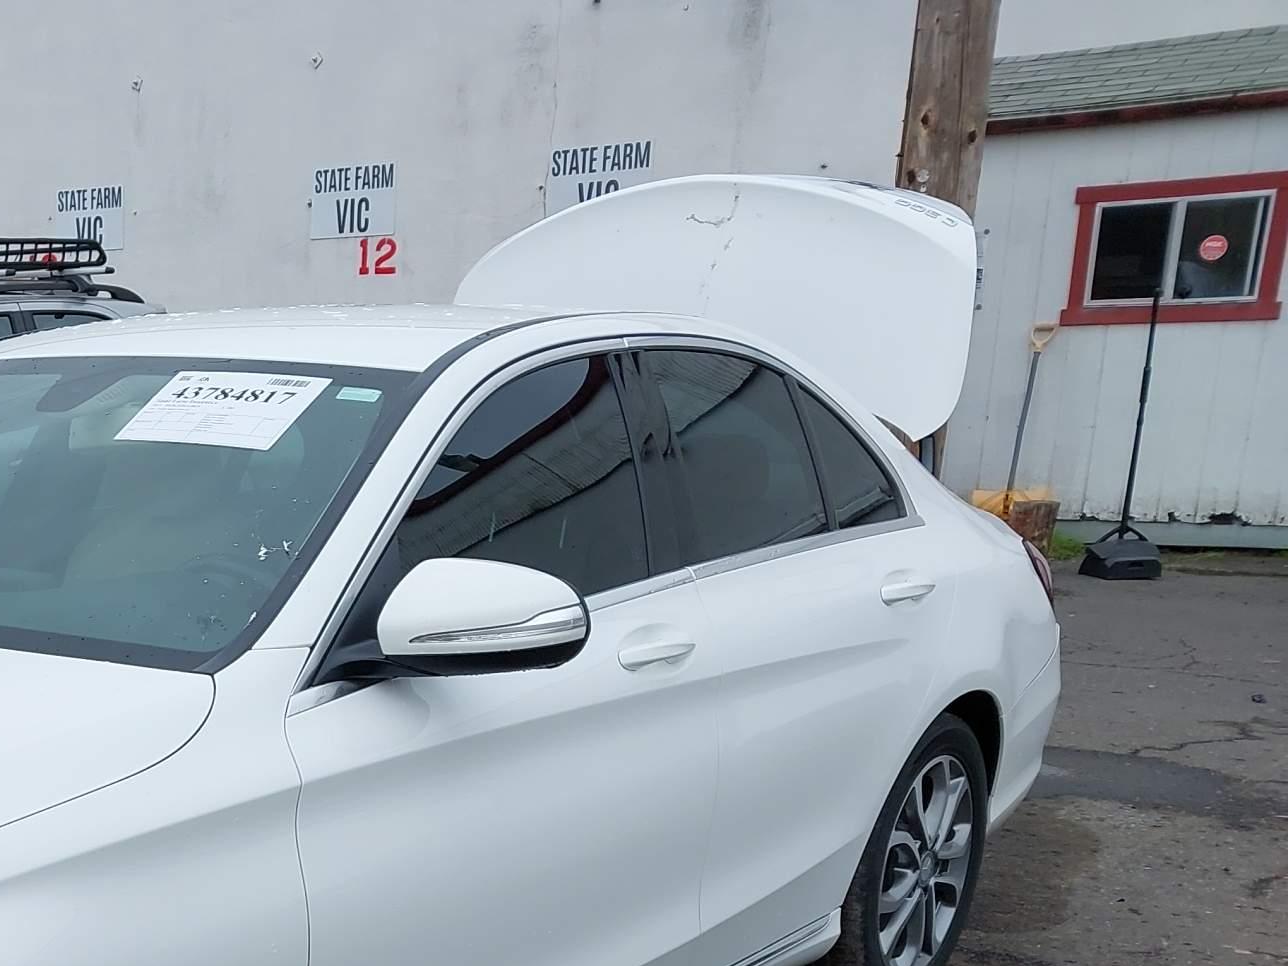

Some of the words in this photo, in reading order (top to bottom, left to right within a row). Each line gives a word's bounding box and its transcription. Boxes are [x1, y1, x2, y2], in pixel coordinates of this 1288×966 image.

[552, 147, 598, 177] STATE
[601, 141, 651, 173] FARM
[315, 167, 352, 194] STATE
[355, 163, 394, 191] FARM
[58, 189, 88, 212] STATE
[90, 186, 122, 210] FARM
[336, 197, 370, 234] VIC
[359, 237, 397, 275] 12
[171, 386, 298, 405] 43784817
